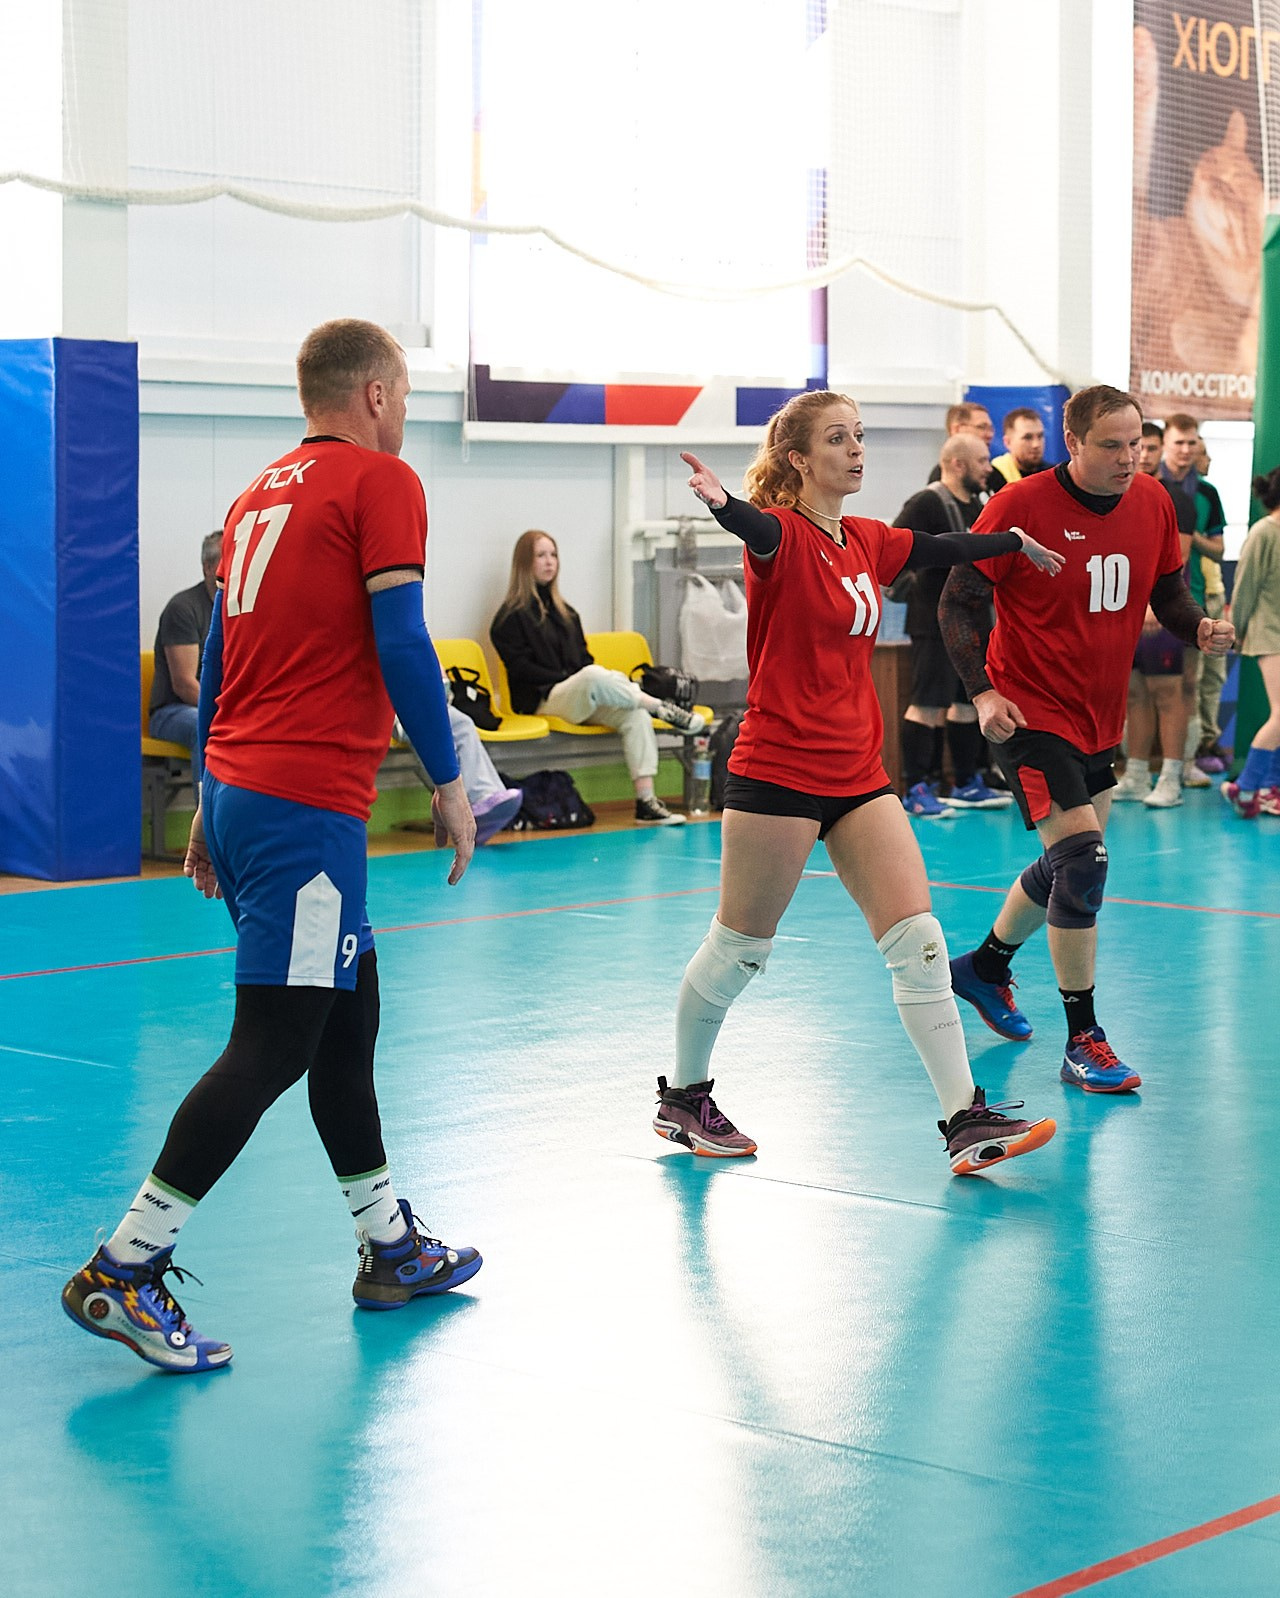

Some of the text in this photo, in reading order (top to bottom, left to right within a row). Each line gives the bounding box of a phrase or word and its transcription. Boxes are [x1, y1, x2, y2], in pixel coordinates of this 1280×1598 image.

[252, 459, 316, 491] ПСК
[227, 503, 293, 617] 17
[1086, 553, 1130, 612] 10
[841, 572, 879, 636] 11
[342, 933, 358, 968] 9
[143, 1192, 172, 1211] NIKE
[129, 1237, 161, 1252] NIKE
